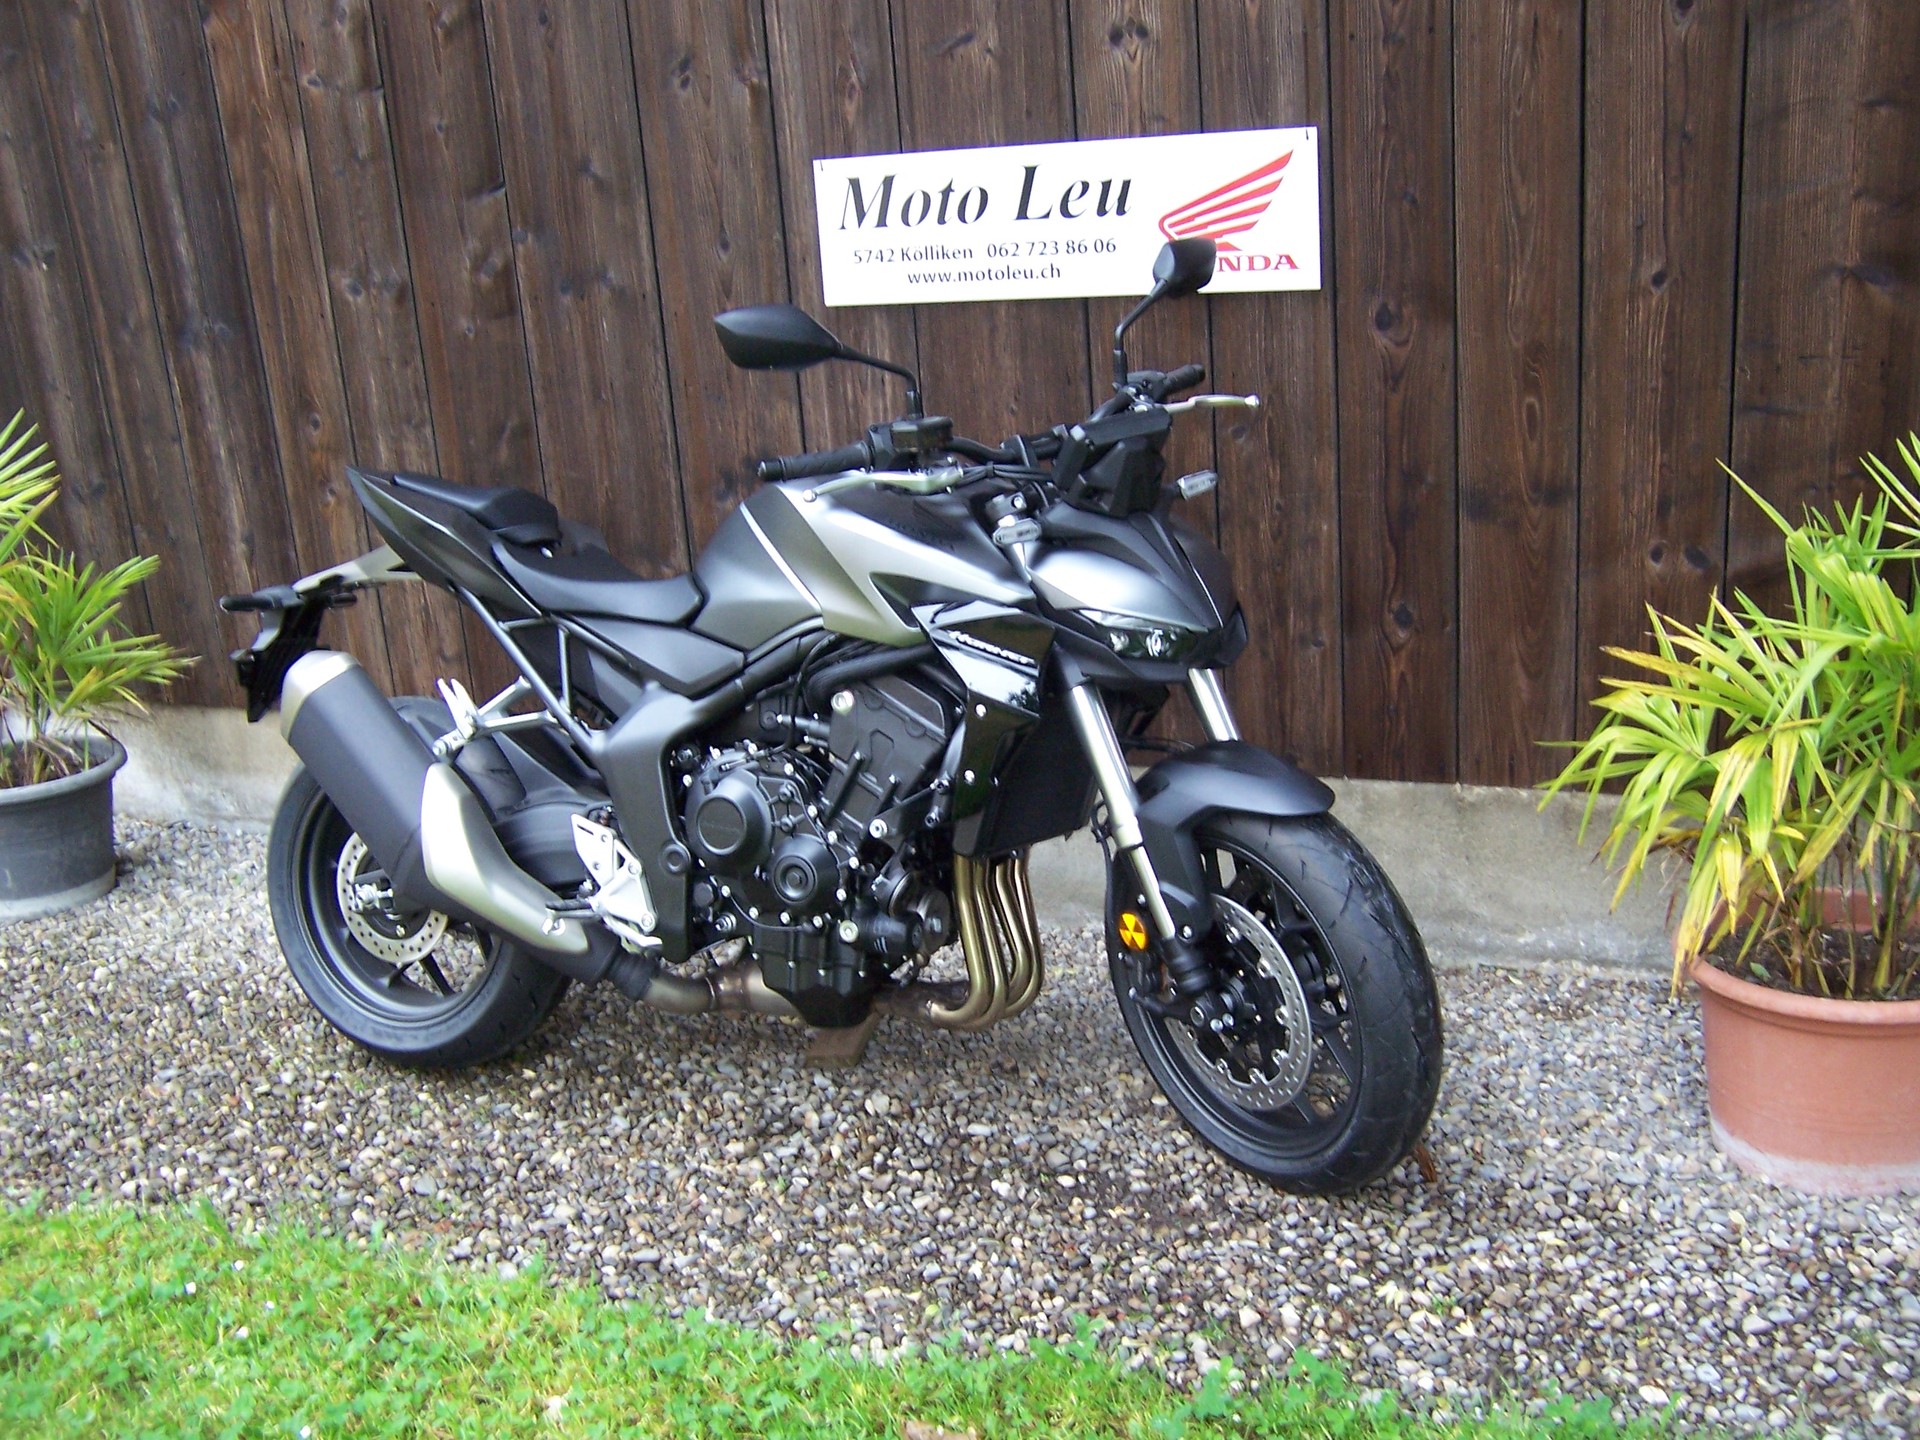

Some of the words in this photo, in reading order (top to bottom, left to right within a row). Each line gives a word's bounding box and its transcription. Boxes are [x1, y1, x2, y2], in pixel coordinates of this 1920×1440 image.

[839, 173, 989, 230] Moto
[1014, 164, 1132, 220] Leu
[853, 248, 895, 264] 5742
[900, 245, 973, 263] Kölliken
[987, 242, 1019, 258] 062
[1026, 240, 1059, 257] 723
[1066, 239, 1088, 255] 86
[1094, 237, 1117, 253] 06
[907, 263, 1061, 284] www.motoleu.ch
[1216, 254, 1300, 272] NDA
